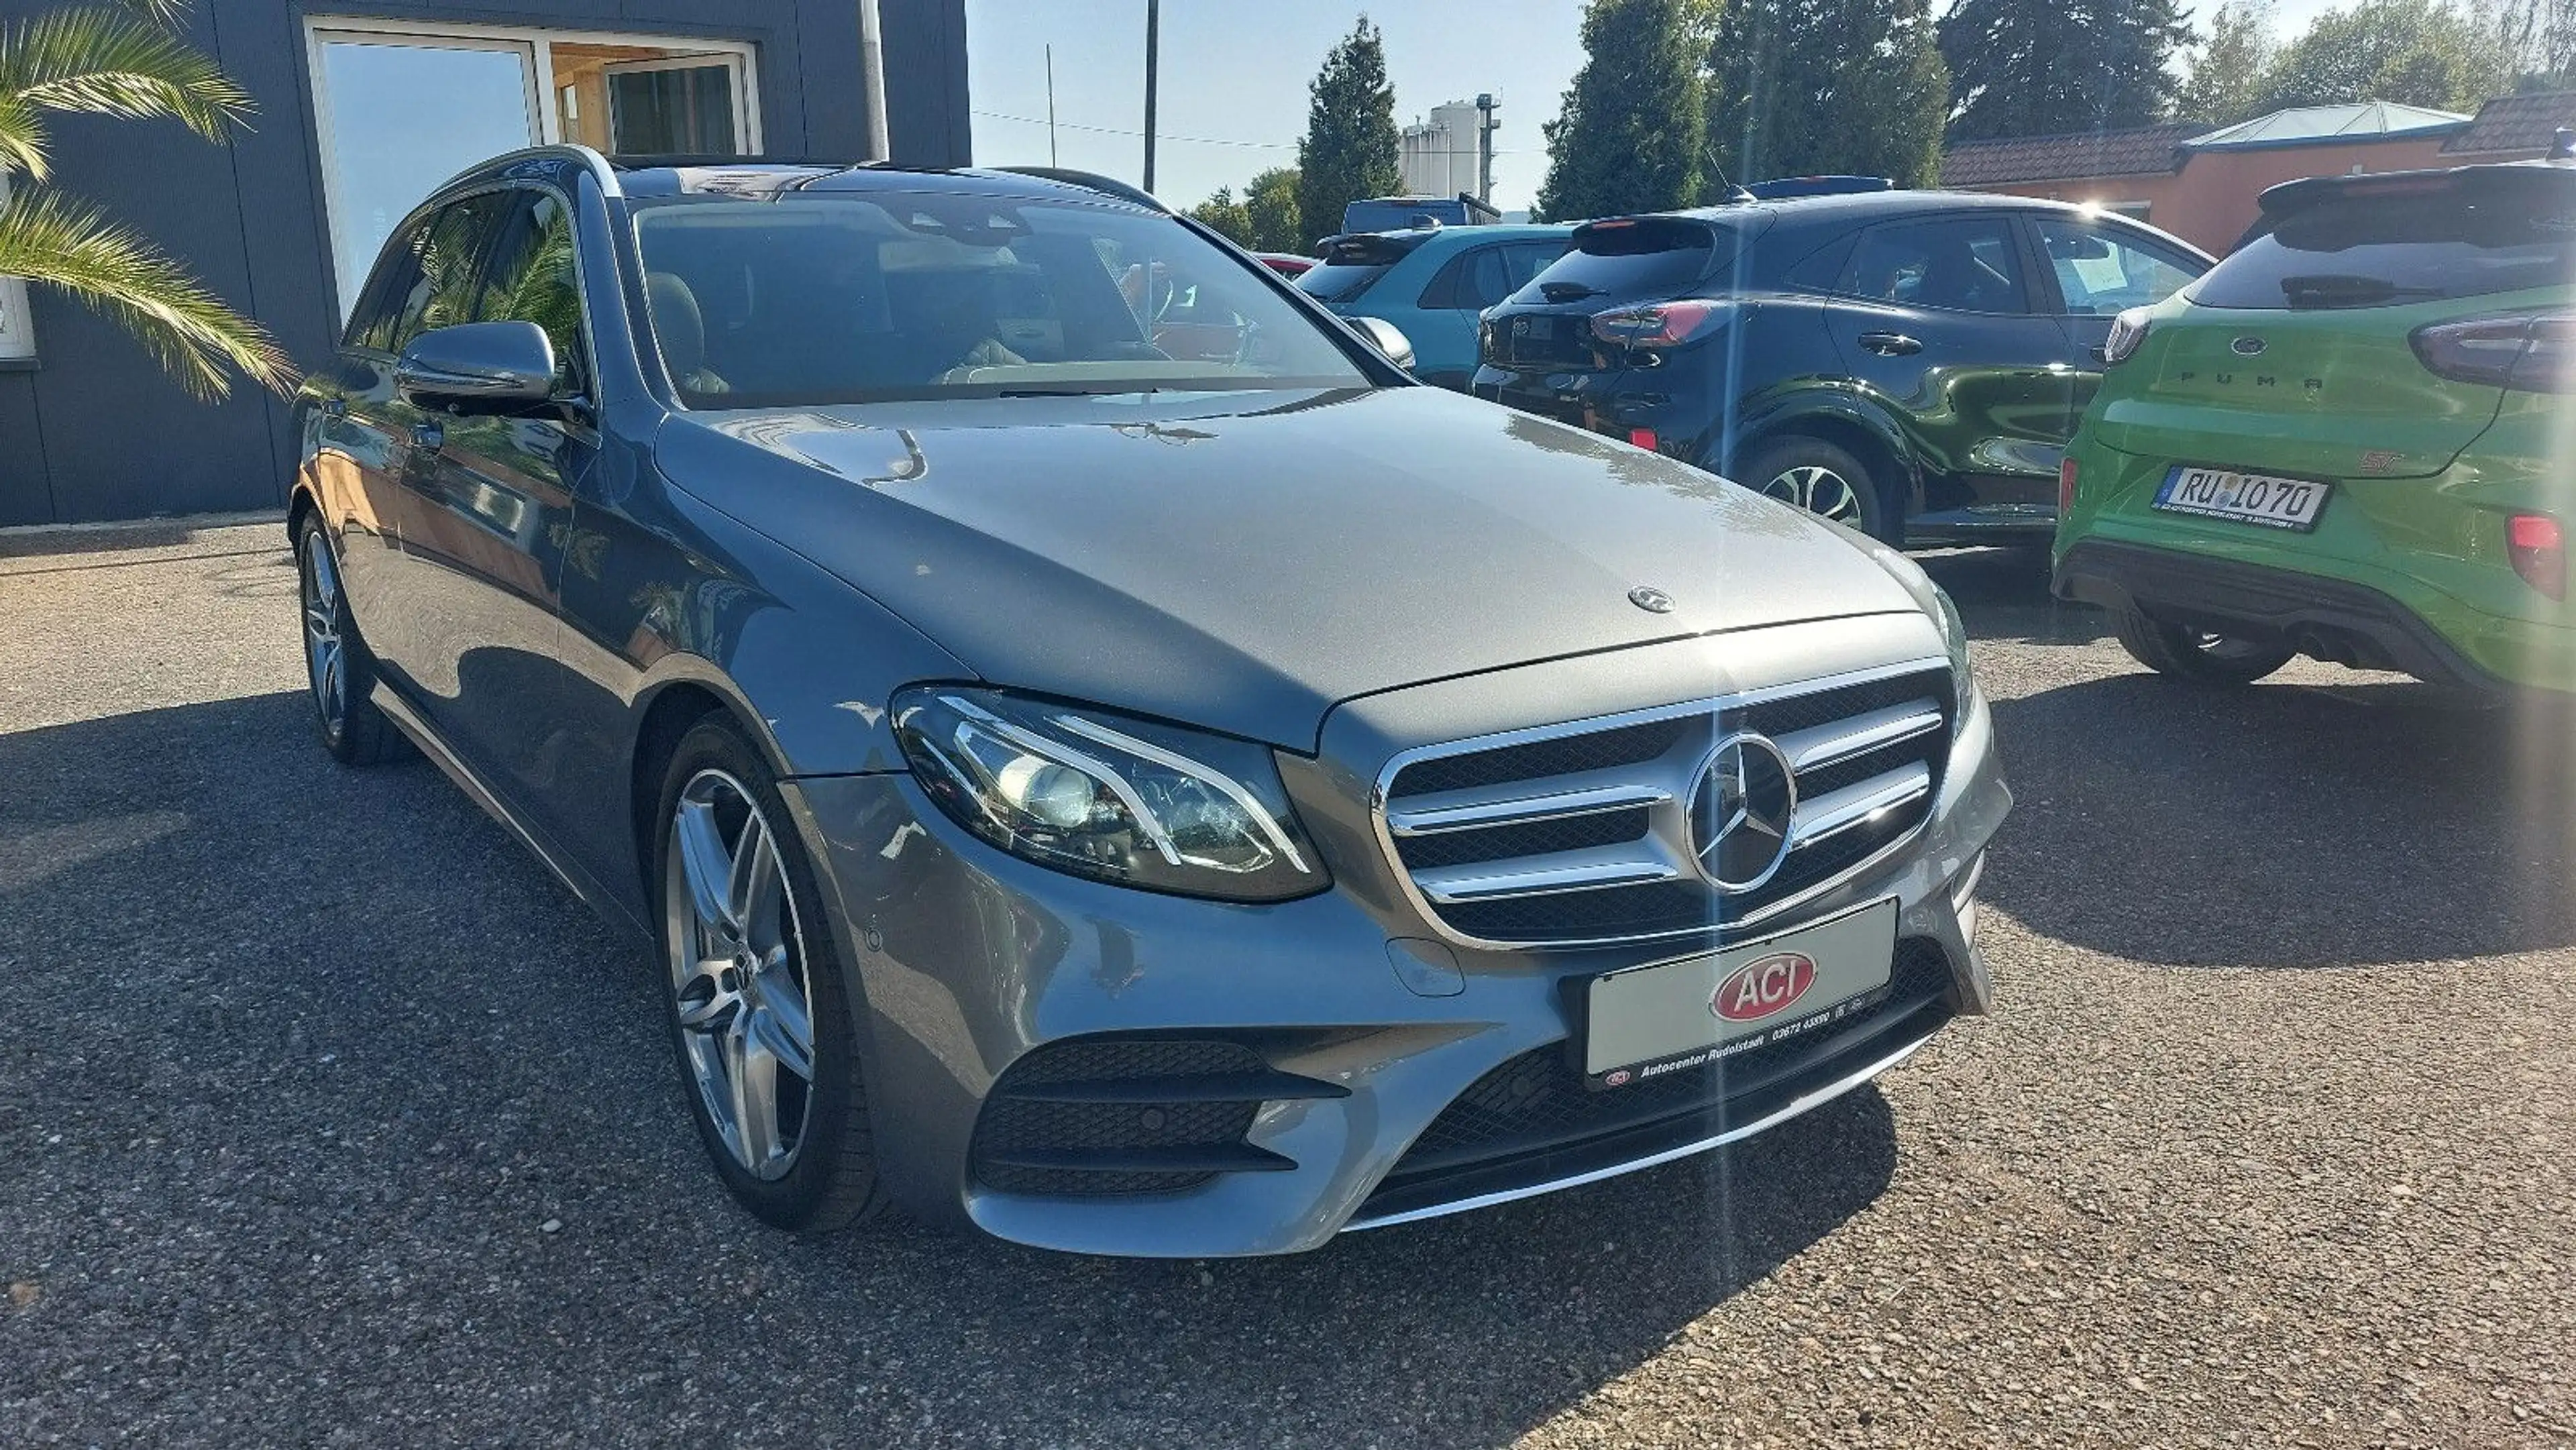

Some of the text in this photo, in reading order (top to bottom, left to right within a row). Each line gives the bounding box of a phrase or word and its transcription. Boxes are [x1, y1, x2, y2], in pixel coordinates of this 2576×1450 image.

[2182, 372, 2323, 389] PUMA
[2180, 473, 2222, 503] RU
[2269, 483, 2312, 516] 70
[1734, 959, 1798, 1012] ACI
[1641, 1053, 1706, 1078] Autocenter
[1709, 1035, 1764, 1061] Rudolstadt
